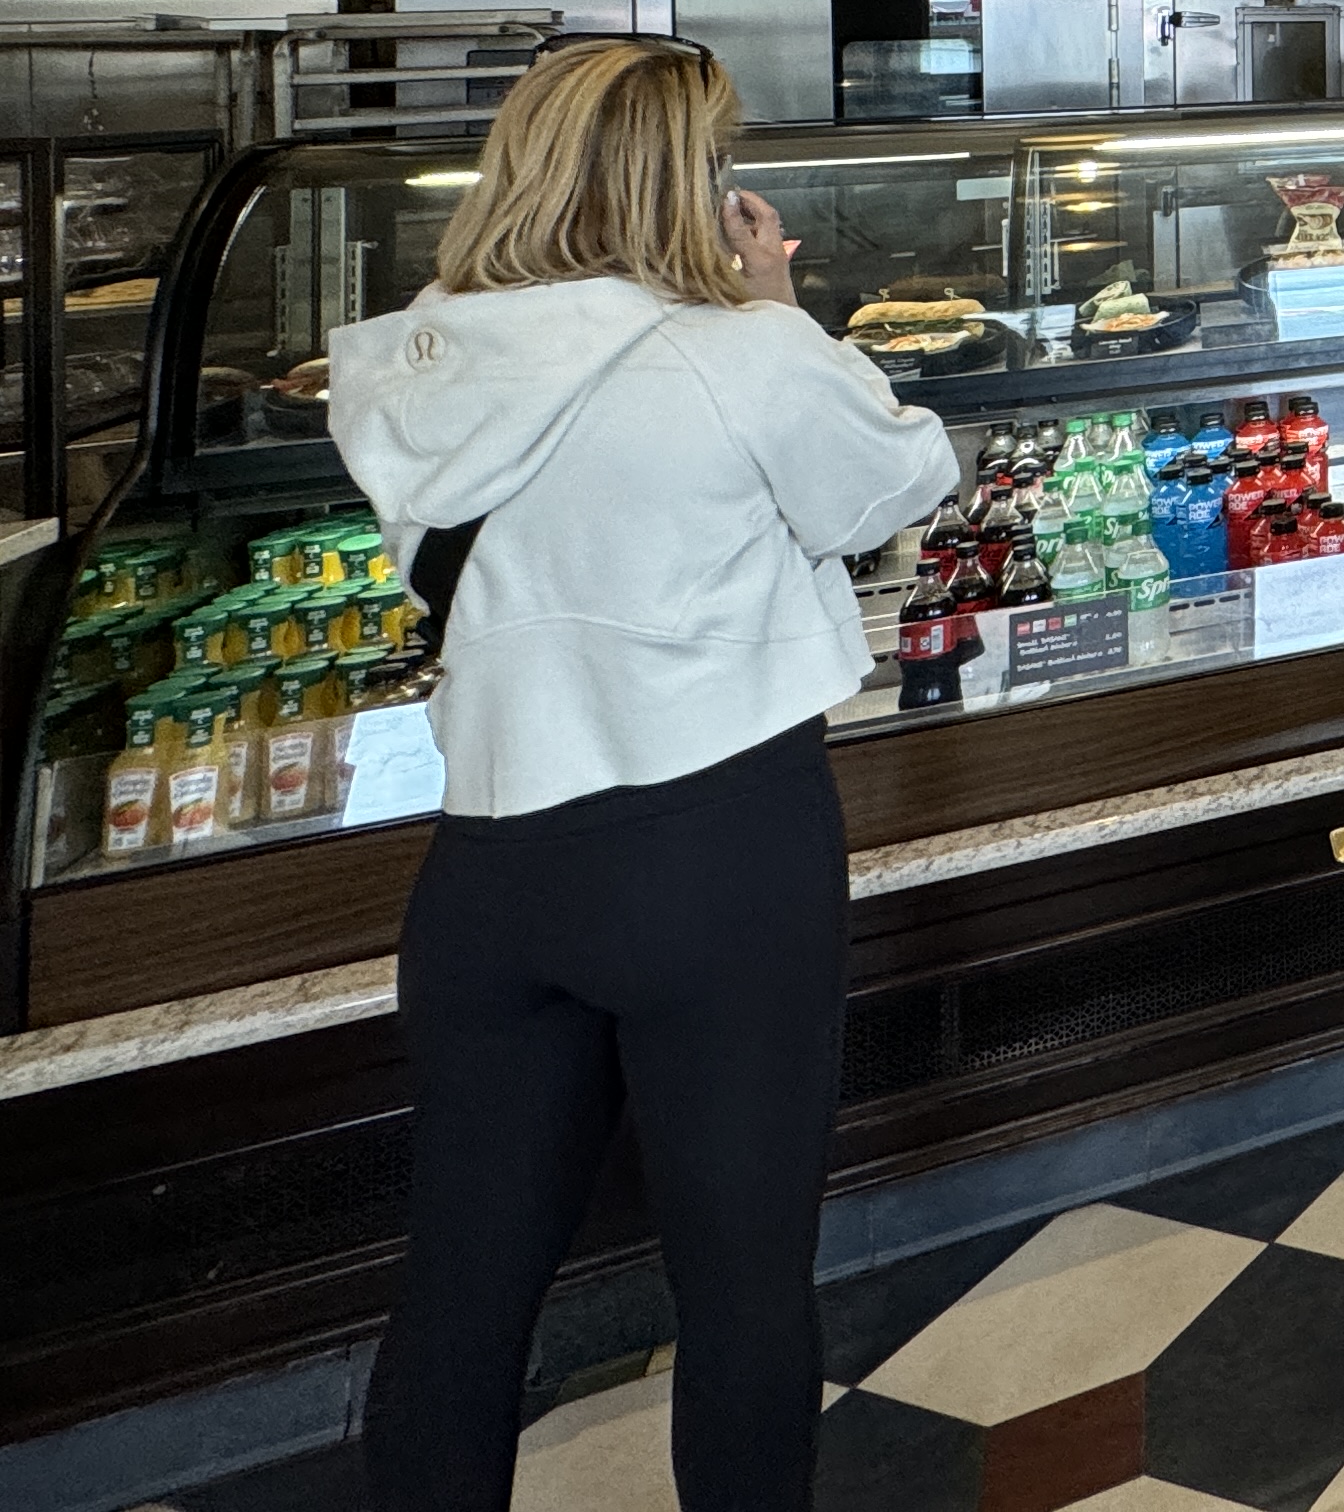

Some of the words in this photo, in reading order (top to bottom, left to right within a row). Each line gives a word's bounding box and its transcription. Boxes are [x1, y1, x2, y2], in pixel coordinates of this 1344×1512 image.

[1152, 496, 1181, 509] POWE
[1228, 490, 1264, 502] POWER
[1189, 498, 1223, 511] POWER
